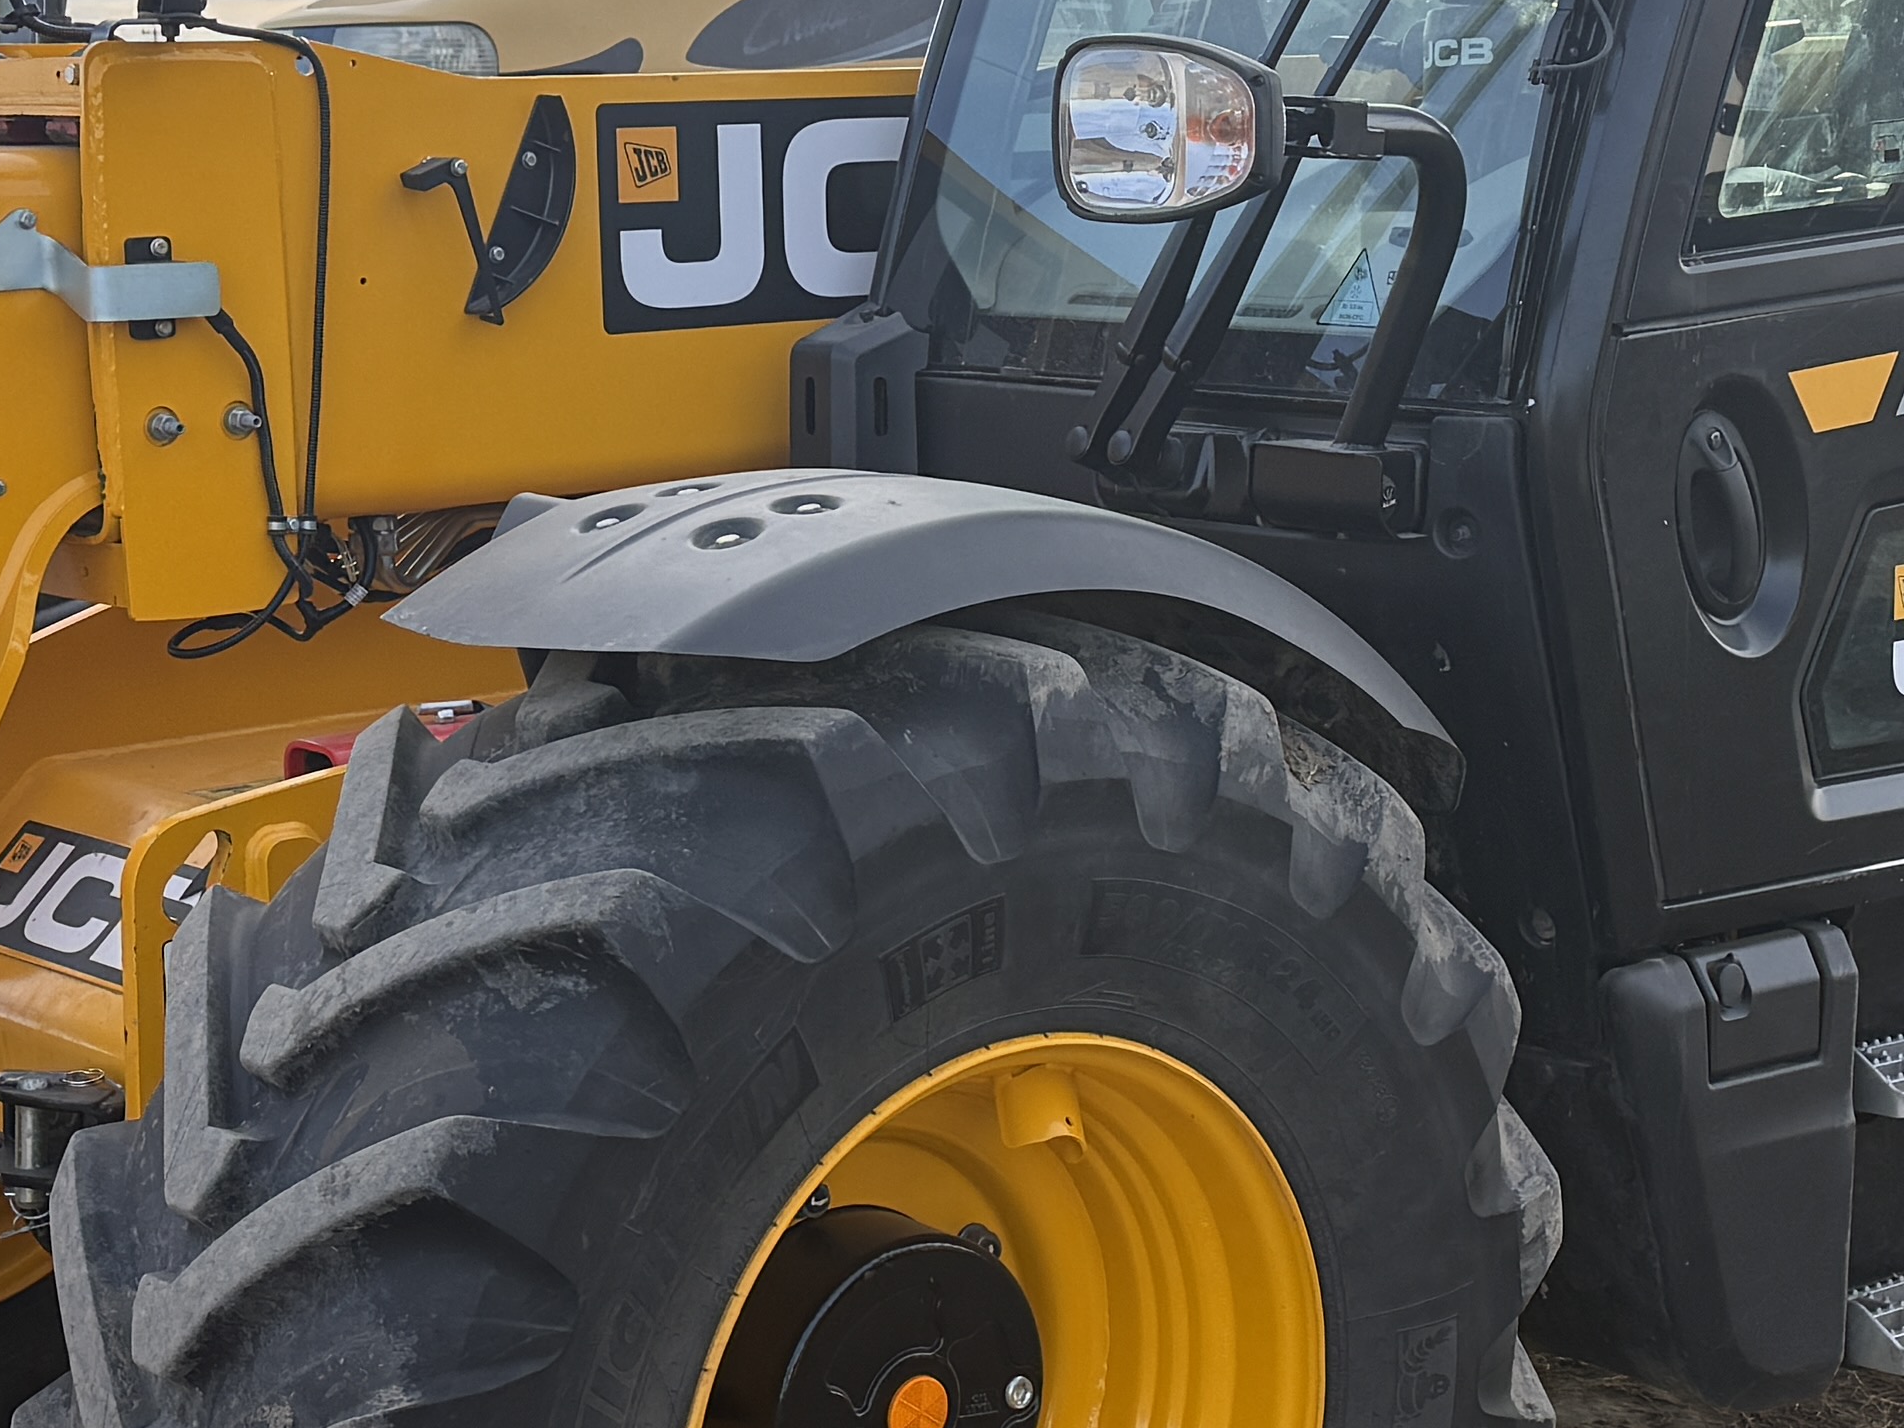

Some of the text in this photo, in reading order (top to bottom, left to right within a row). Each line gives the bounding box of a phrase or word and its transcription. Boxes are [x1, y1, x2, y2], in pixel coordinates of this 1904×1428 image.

[1423, 37, 1494, 69] JCB
[632, 142, 671, 182] JCB
[619, 117, 910, 310] JC
